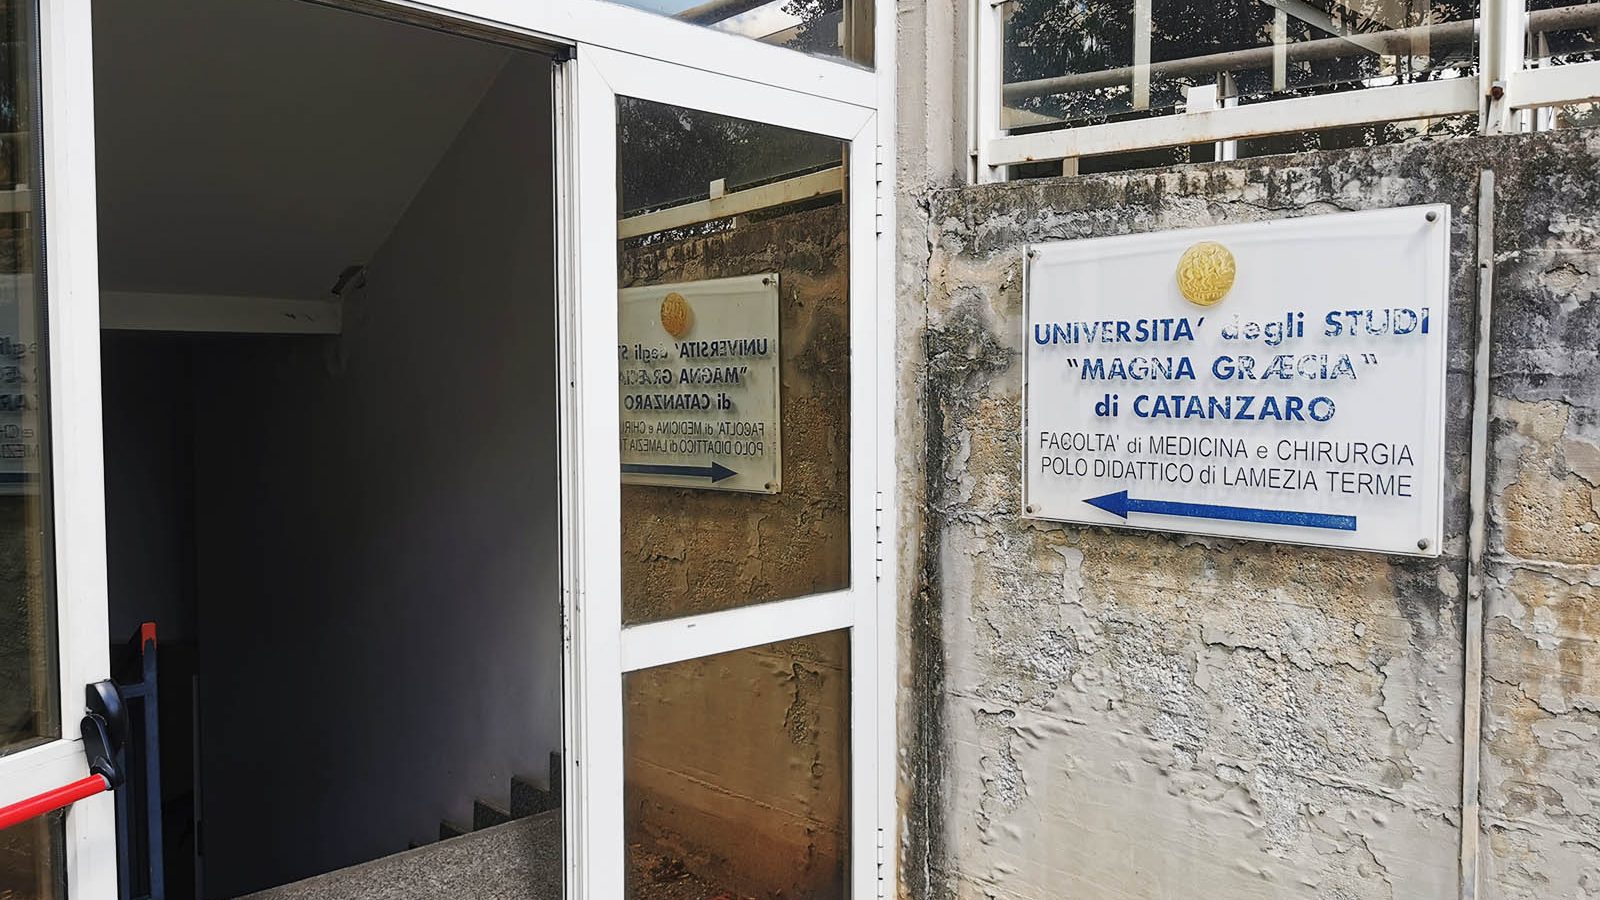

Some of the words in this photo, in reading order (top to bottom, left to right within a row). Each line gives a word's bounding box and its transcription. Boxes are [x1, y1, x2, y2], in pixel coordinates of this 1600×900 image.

[1221, 312, 1304, 346] degli
[1324, 308, 1429, 336] STUDI
[1066, 356, 1197, 381] "MAGNA
[1095, 394, 1119, 418] di
[1132, 395, 1336, 422] CATANZARO
[1040, 432, 1120, 453] FACOLTA'
[1127, 437, 1142, 454] di
[1149, 435, 1248, 459] MEDICINA
[1256, 445, 1268, 458] e
[1277, 439, 1414, 466] CHIRURGIA
[1041, 457, 1088, 477] POLO
[1094, 459, 1194, 484] DIDATTICO
[1199, 466, 1217, 485] di
[1223, 466, 1318, 492] LAMEZIA
[1325, 471, 1412, 498] TERME
